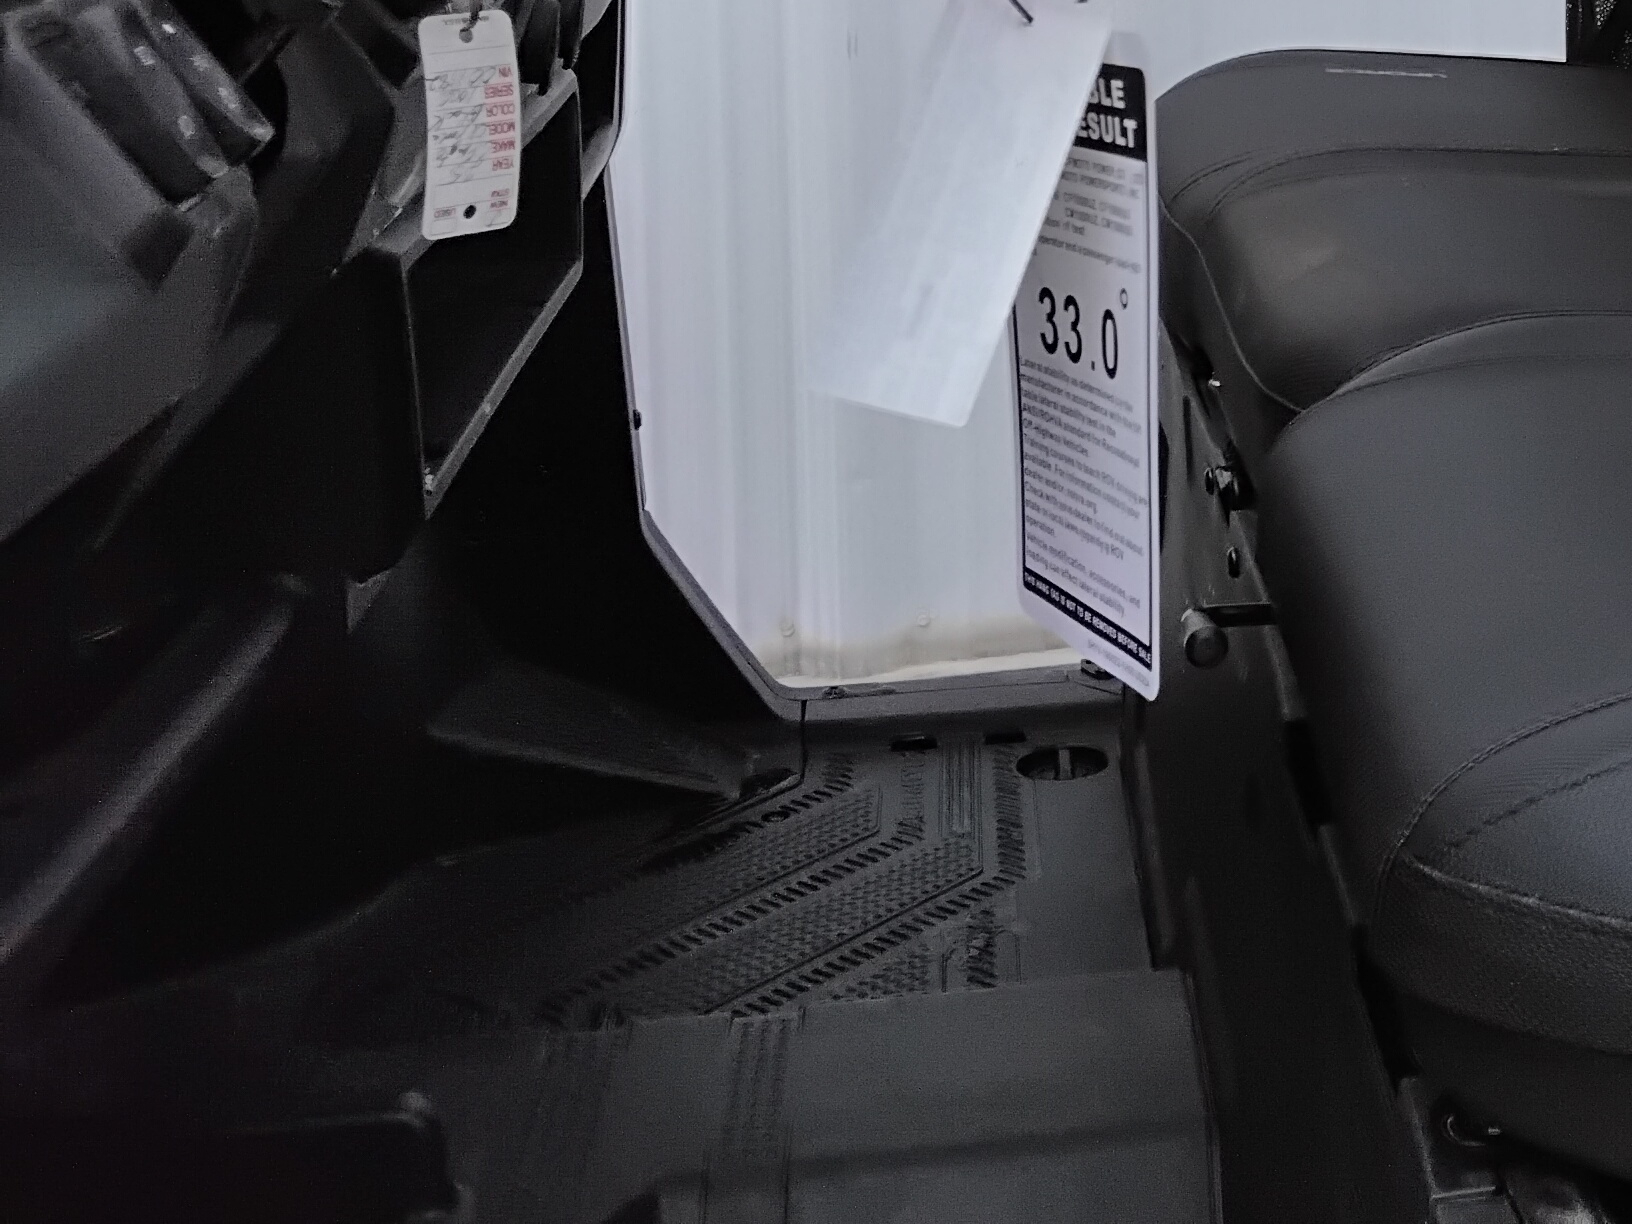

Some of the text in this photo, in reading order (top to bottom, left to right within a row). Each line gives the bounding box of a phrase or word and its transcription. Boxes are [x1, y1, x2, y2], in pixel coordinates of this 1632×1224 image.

[487, 105, 515, 116] COLOR
[1077, 112, 1138, 148] ESULT
[492, 159, 514, 171] YEAR
